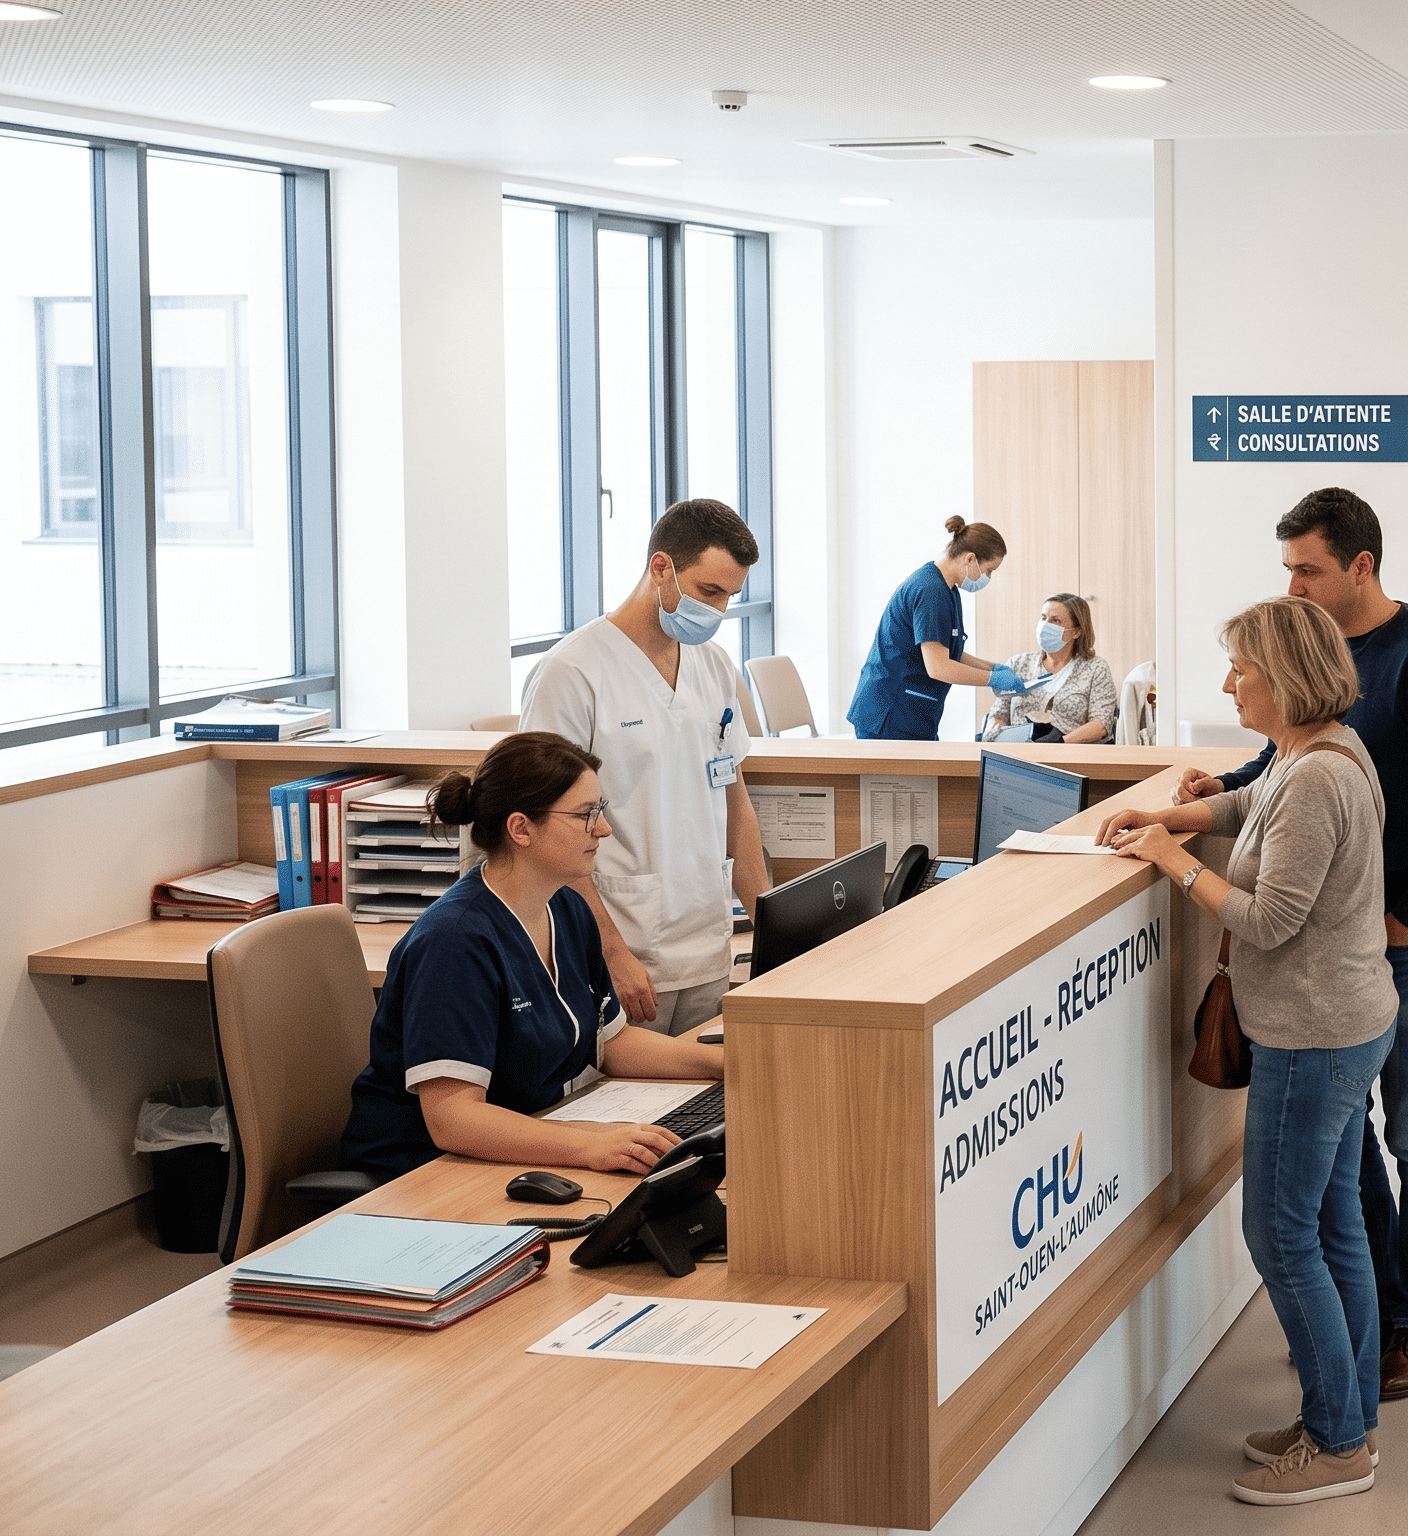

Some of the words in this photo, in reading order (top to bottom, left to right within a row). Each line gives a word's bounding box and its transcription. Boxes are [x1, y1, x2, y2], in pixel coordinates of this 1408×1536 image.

[1237, 404, 1292, 423] SALLE
[1296, 404, 1392, 423] D'ATTENTE
[1237, 433, 1380, 452] CONSULTATIONS
[938, 1005, 1039, 1119] ACCUEIL
[1057, 917, 1162, 1033] RÉCEPTION
[938, 1058, 1065, 1195] ADMISSIONS
[1011, 1130, 1084, 1250] CHU
[974, 1173, 1120, 1337] SAINT-OUEN-L'AUMÔNE
